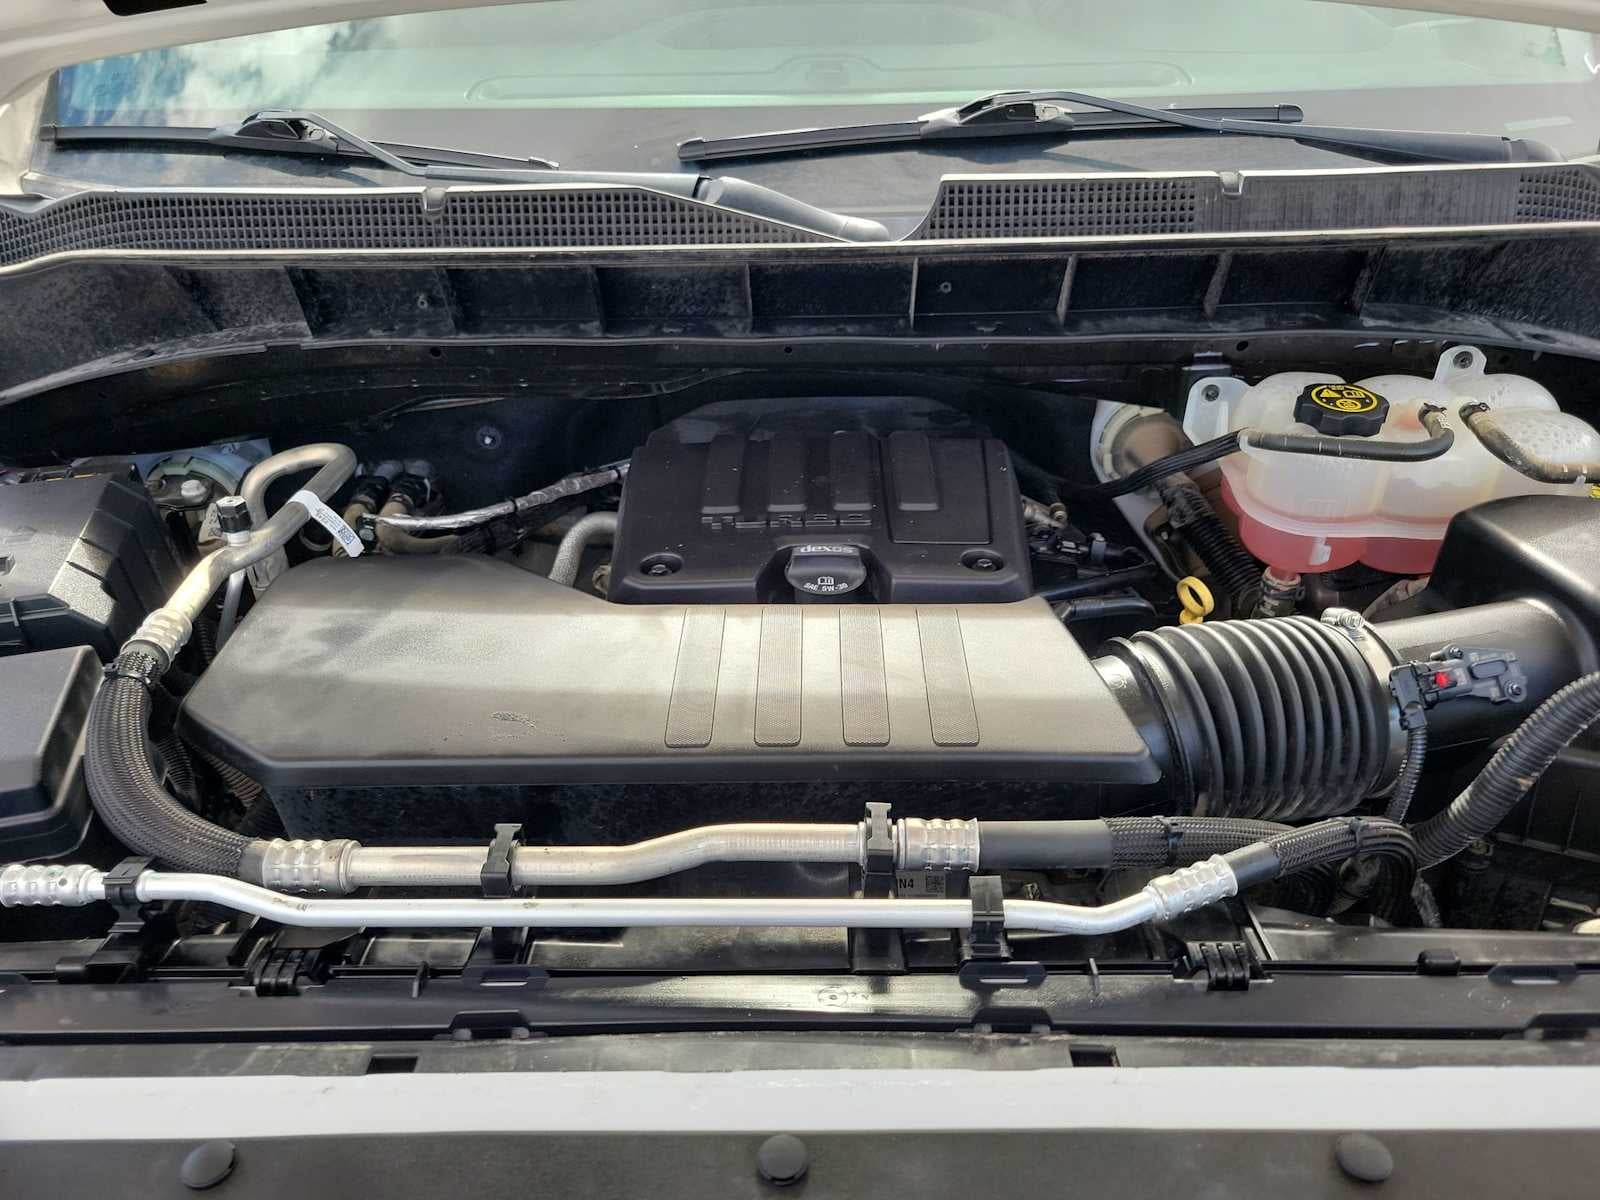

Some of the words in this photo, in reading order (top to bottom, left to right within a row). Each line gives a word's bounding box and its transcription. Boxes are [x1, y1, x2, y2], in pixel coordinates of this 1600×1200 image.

[701, 513, 872, 530] TURBO
[800, 545, 854, 554] dexos
[803, 582, 818, 592] SAE
[896, 878, 914, 889] N4
